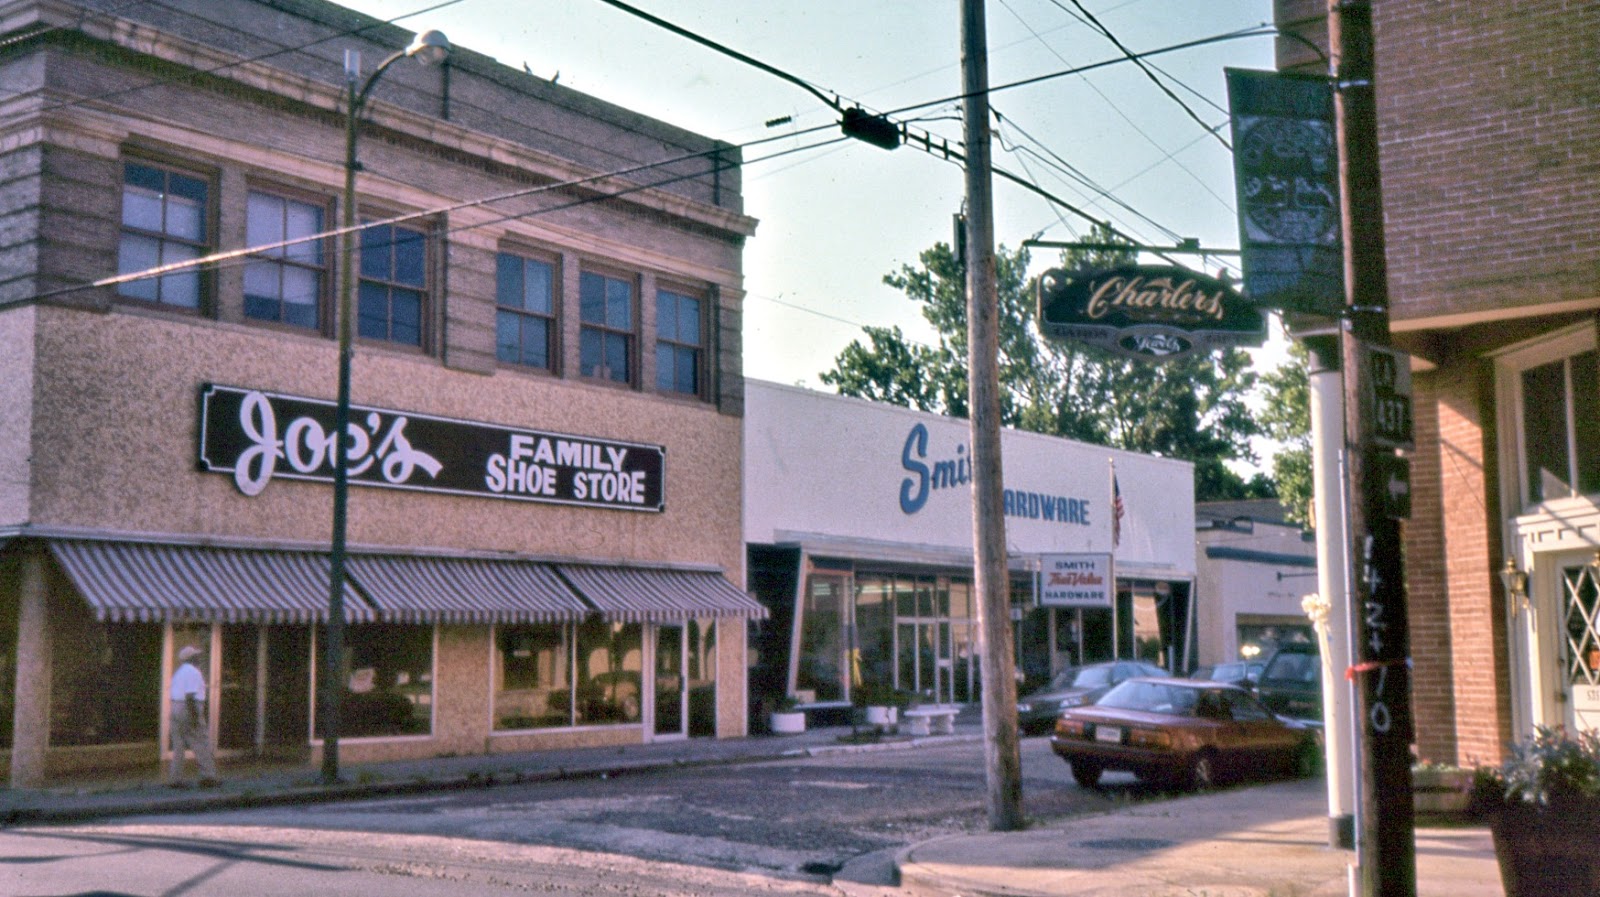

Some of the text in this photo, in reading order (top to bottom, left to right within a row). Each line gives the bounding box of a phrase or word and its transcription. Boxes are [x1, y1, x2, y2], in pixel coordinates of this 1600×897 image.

[510, 435, 629, 472] FAMILY
[900, 423, 972, 514] Smi
[485, 454, 646, 504] SHOE STORE
[1003, 489, 1091, 526] ARDWARE
[1055, 561, 1095, 570] SMITH
[1045, 591, 1105, 600] HARDWARE
